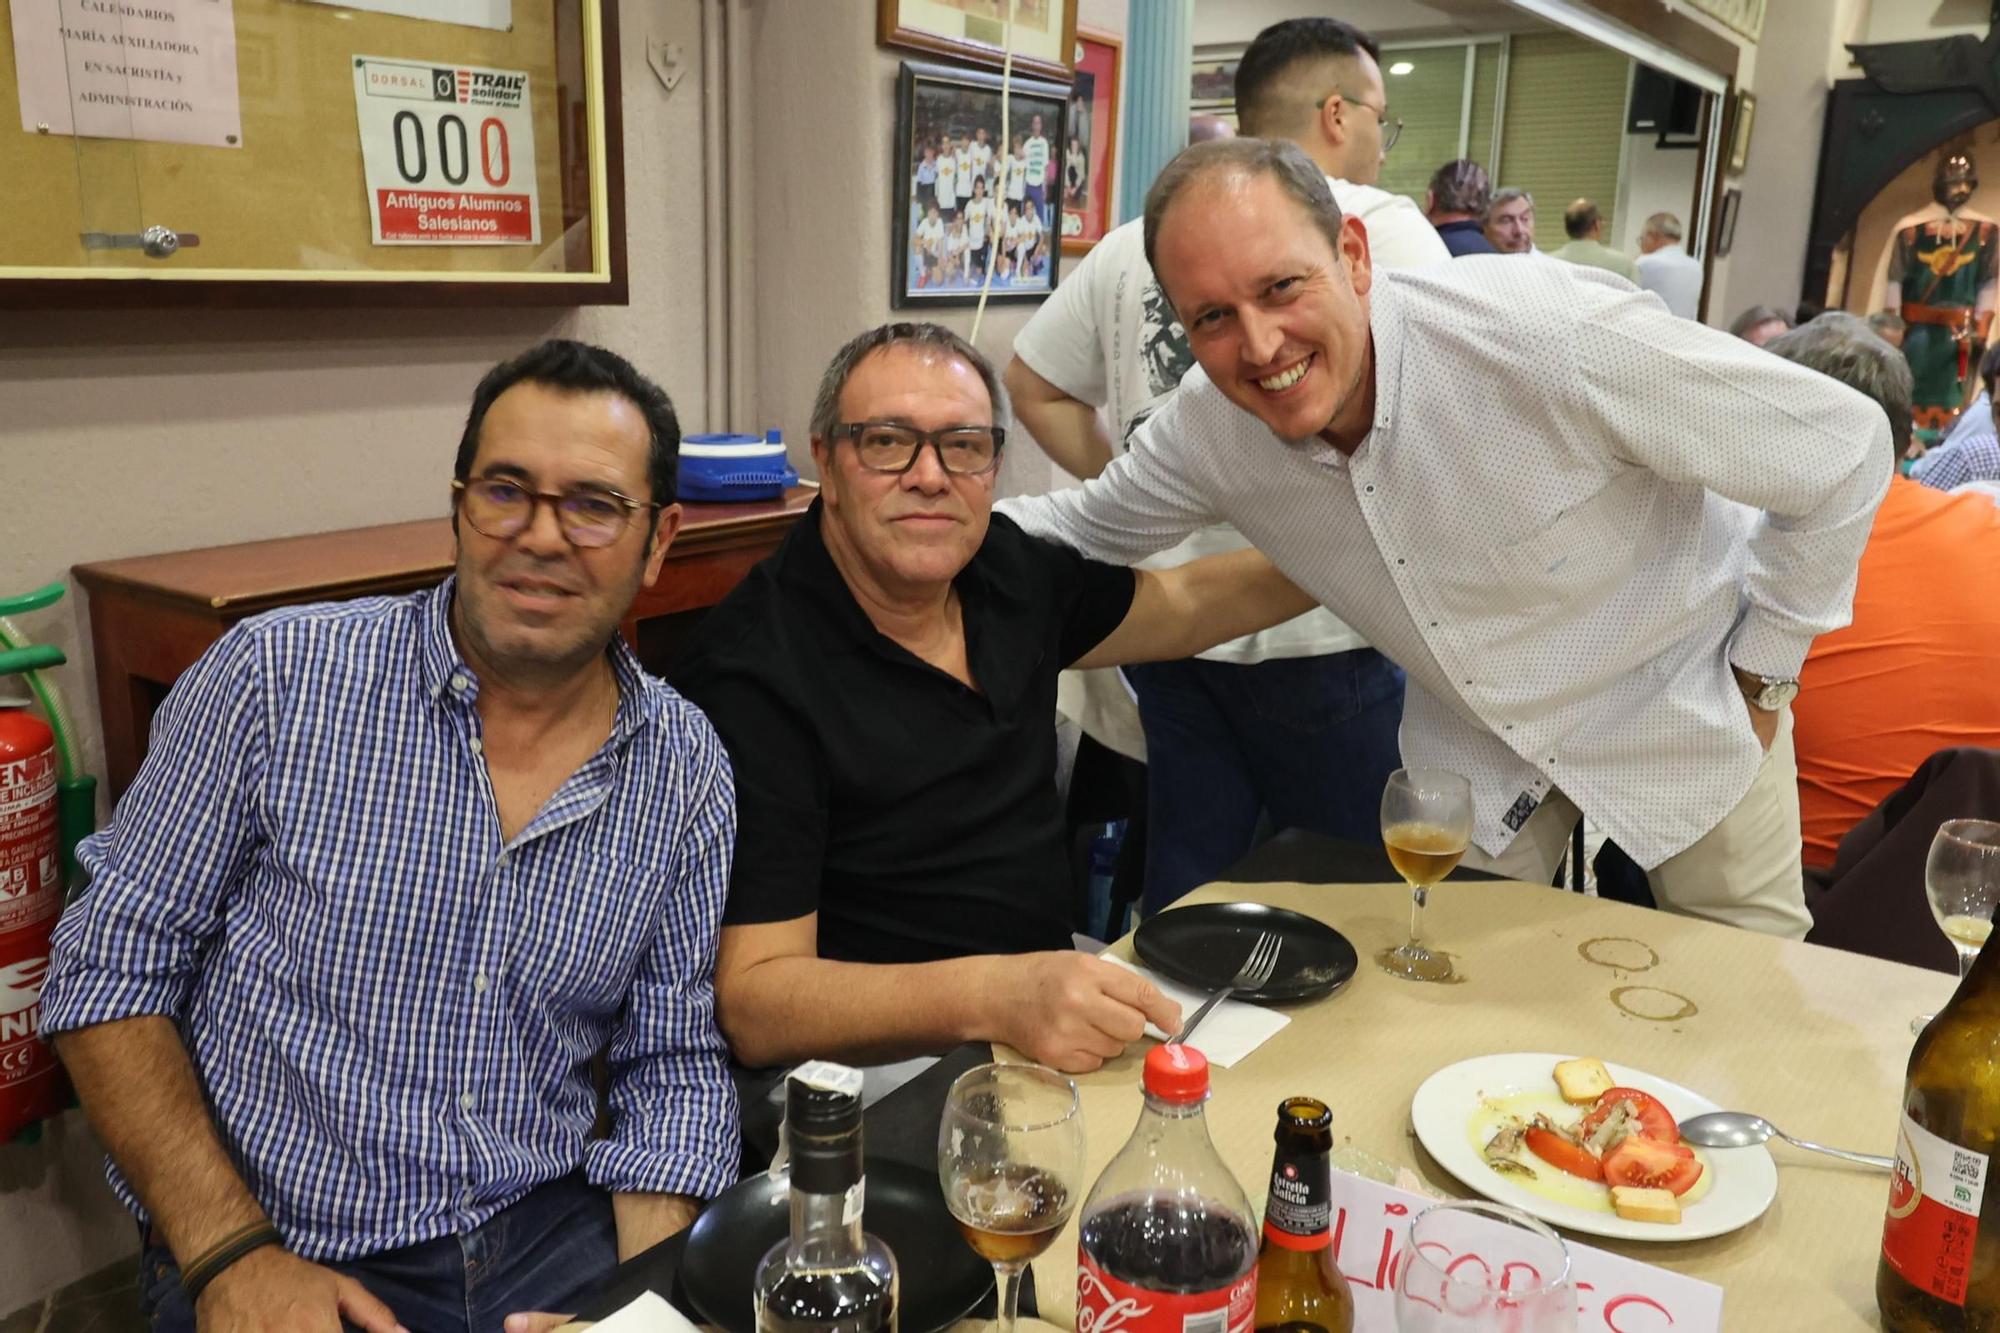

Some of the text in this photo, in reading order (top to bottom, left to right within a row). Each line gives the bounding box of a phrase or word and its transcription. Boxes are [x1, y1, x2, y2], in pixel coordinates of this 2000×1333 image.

[80, 0, 175, 22] CALENDARIOS
[59, 26, 200, 56] MARÍA AUXILIADORA
[84, 60, 102, 73] EN
[105, 64, 174, 82] SACRISTÍA
[371, 73, 427, 89] DORSAL
[79, 91, 194, 113] ADMINISTRACIÓN
[471, 87, 522, 101] solidari
[386, 191, 523, 213] Antiguos Alumnos
[417, 214, 498, 231] Salesianos
[1274, 1172, 1310, 1195] Estrella
